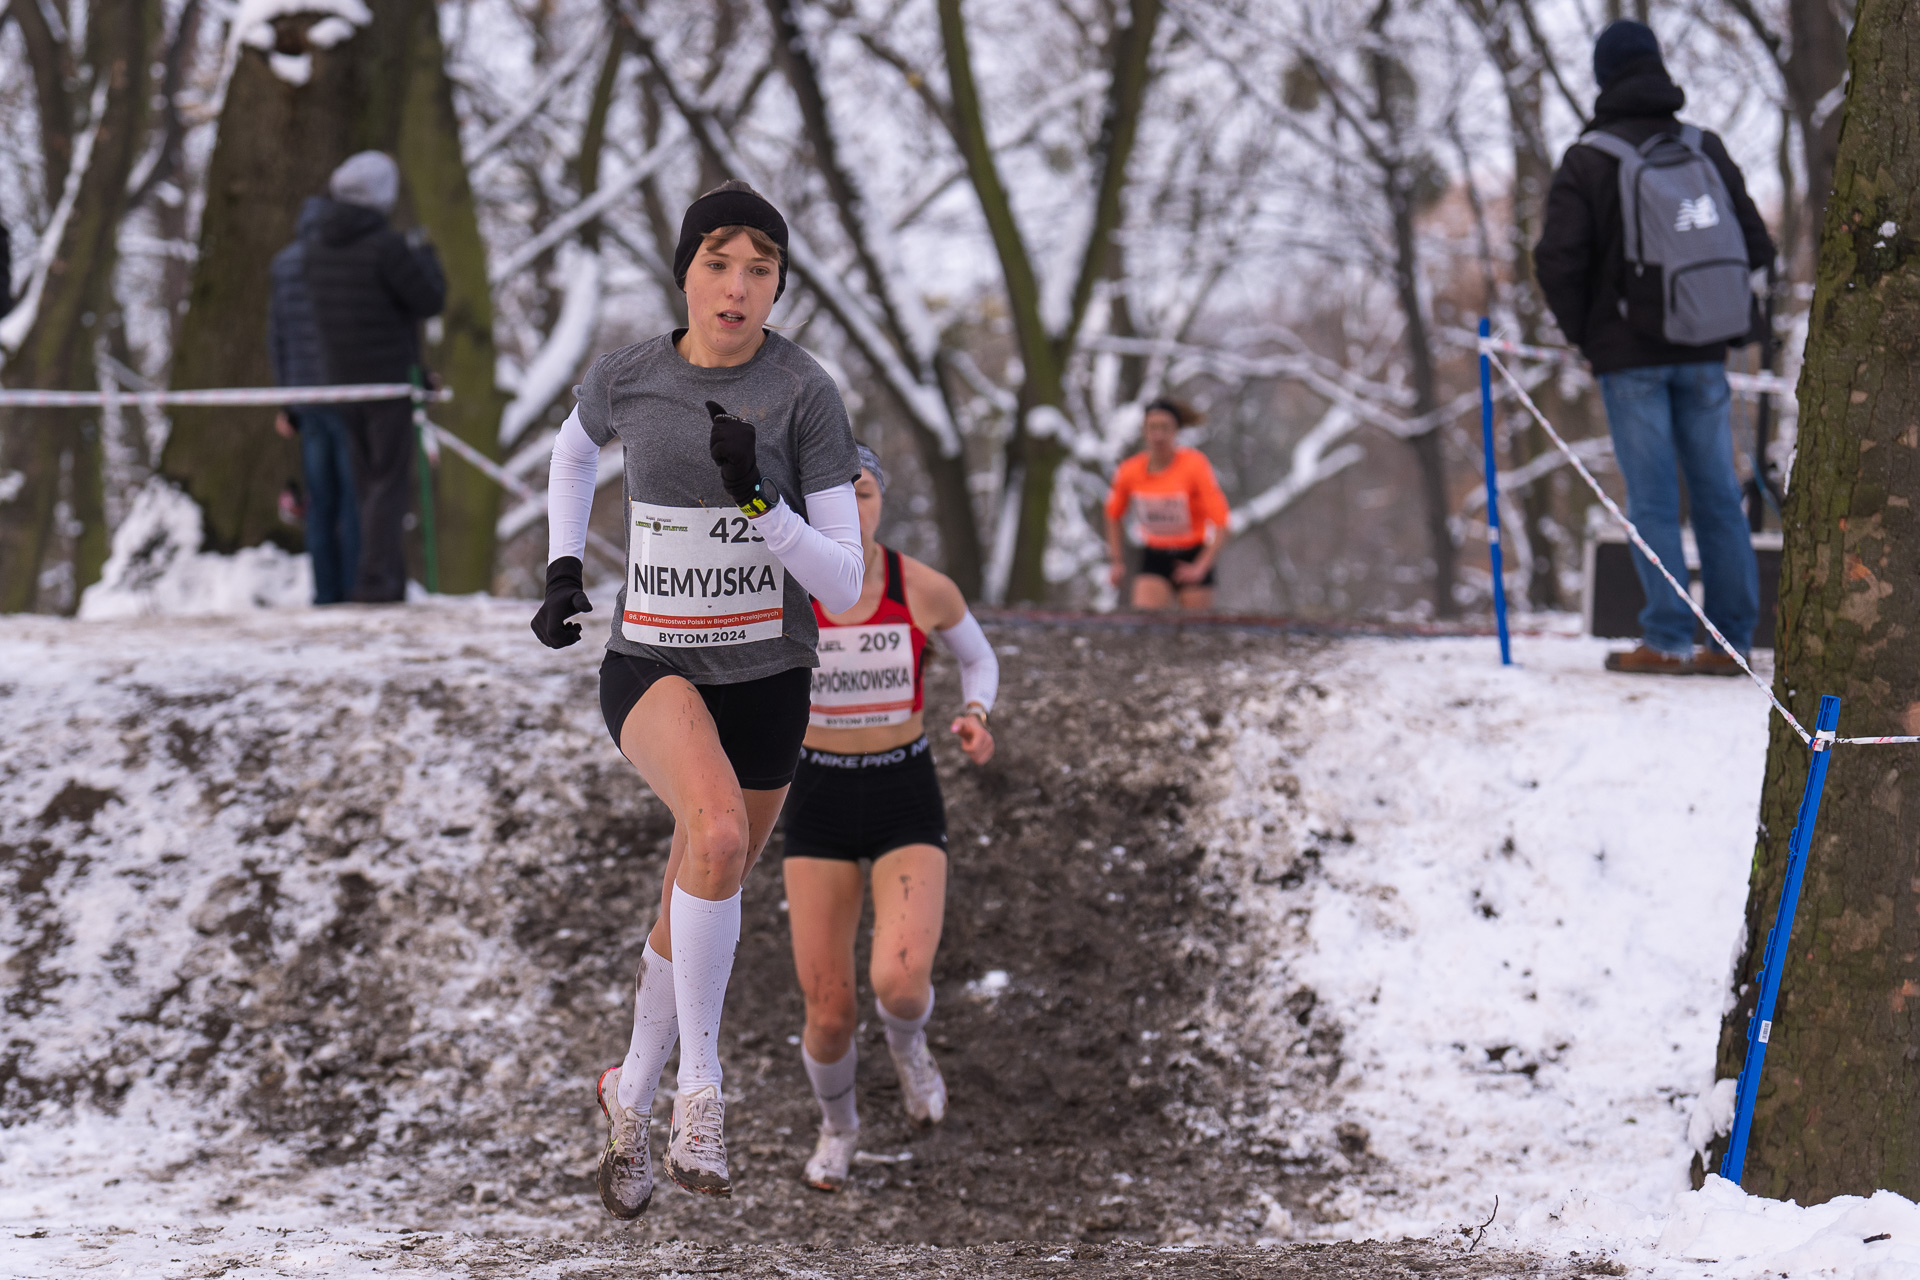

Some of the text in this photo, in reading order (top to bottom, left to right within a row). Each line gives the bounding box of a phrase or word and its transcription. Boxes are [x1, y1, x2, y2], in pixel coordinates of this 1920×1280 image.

[634, 563, 777, 598] NIEMYJSKA
[652, 616, 687, 625] Mistrzostwa
[713, 616, 740, 625] Biegach
[659, 629, 747, 643] BYTOM 2024
[859, 631, 901, 652] 209
[810, 751, 859, 768] NIKE
[861, 748, 906, 768] PRO
